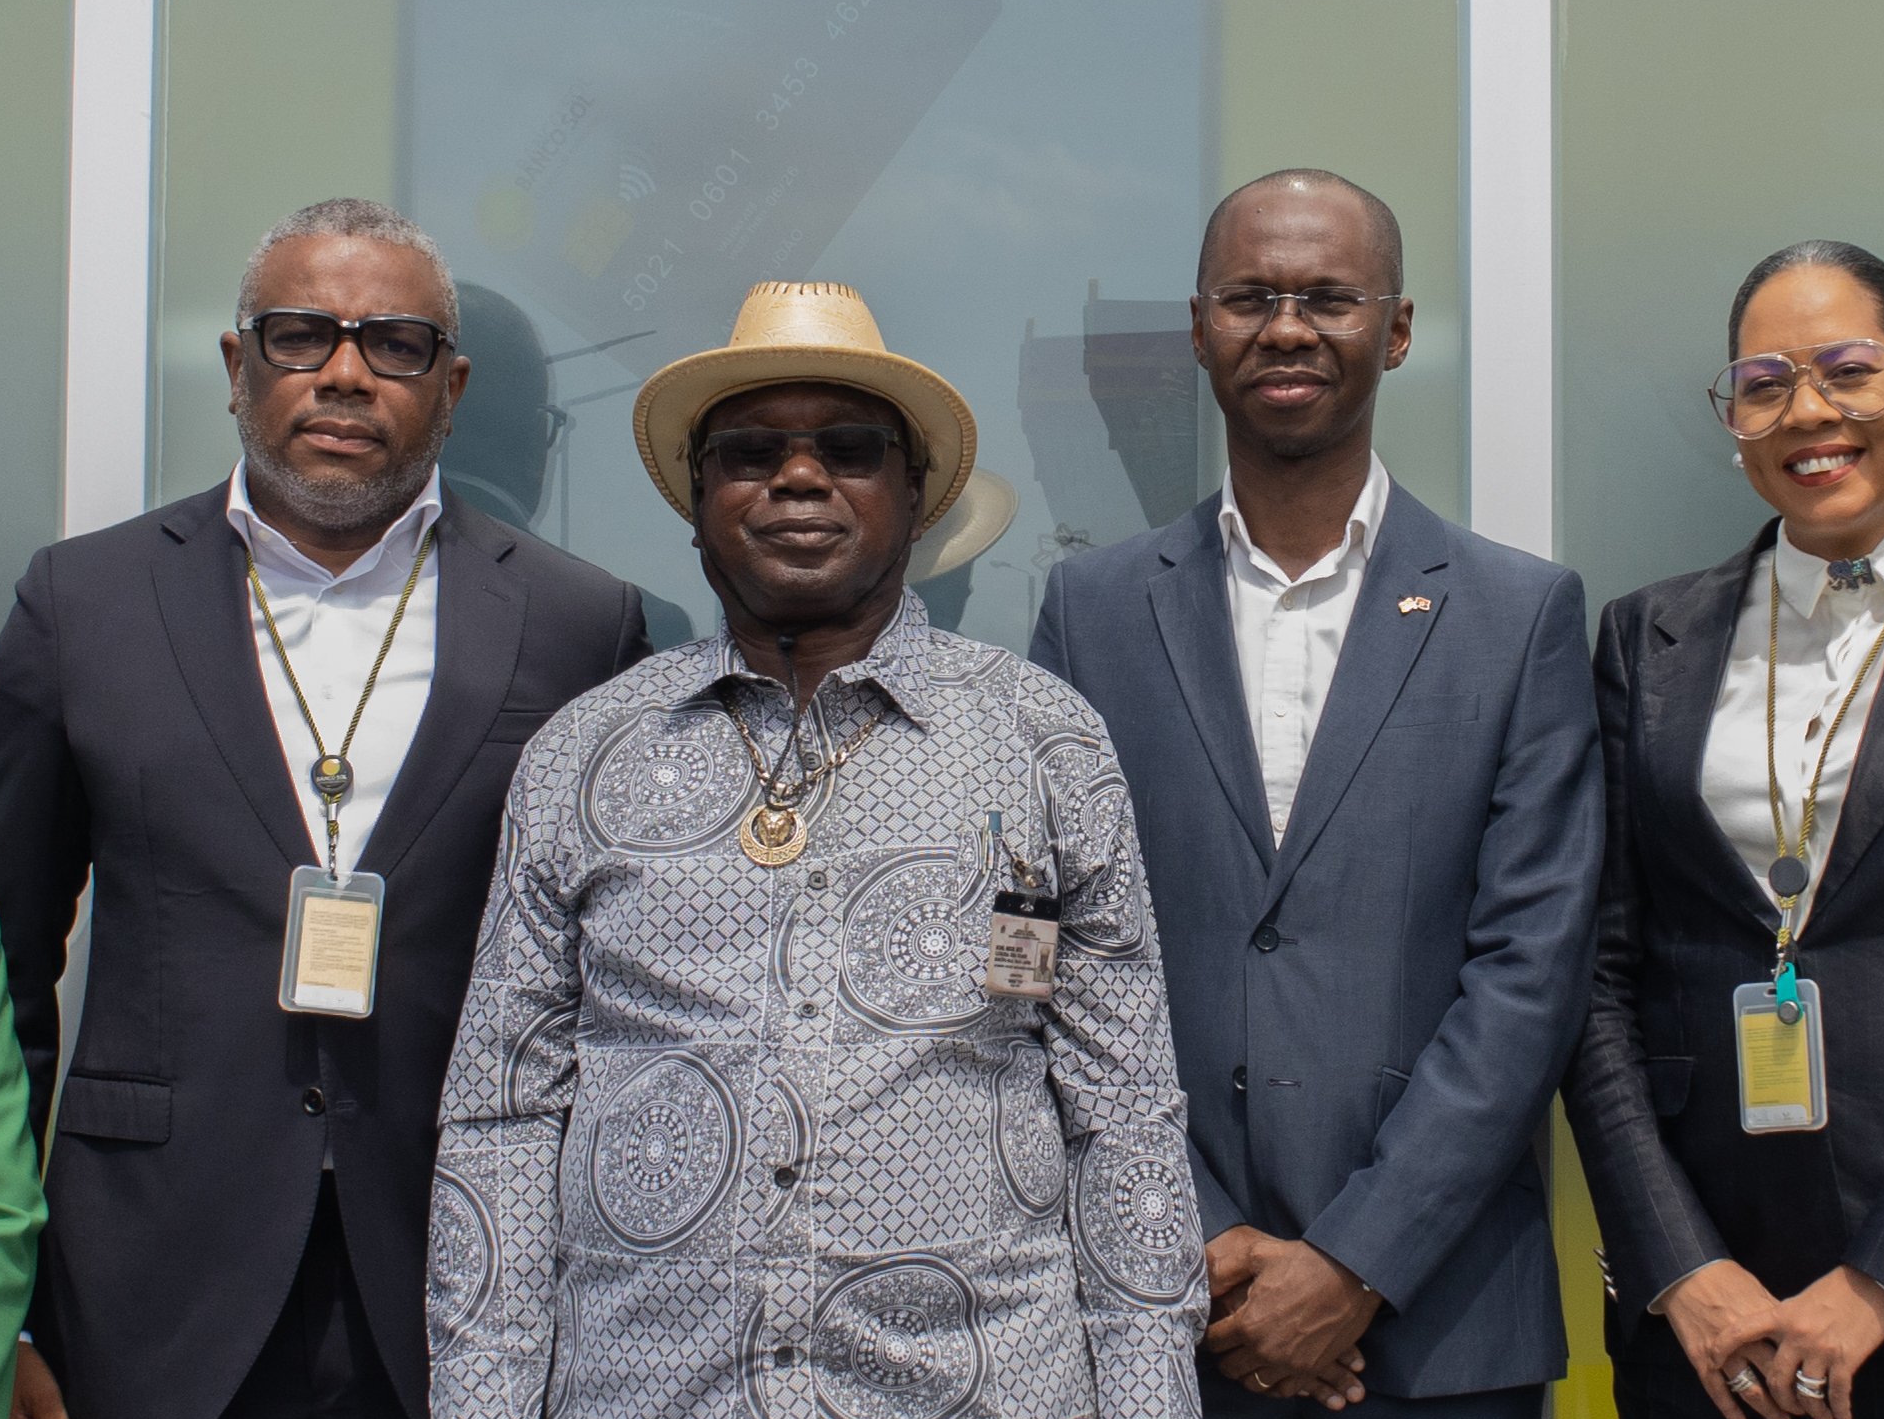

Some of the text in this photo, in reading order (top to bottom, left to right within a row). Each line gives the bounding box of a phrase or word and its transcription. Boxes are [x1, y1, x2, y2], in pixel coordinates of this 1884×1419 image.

[621, 238, 683, 312] 5021
[687, 147, 750, 222] 0601
[754, 54, 819, 131] 3453
